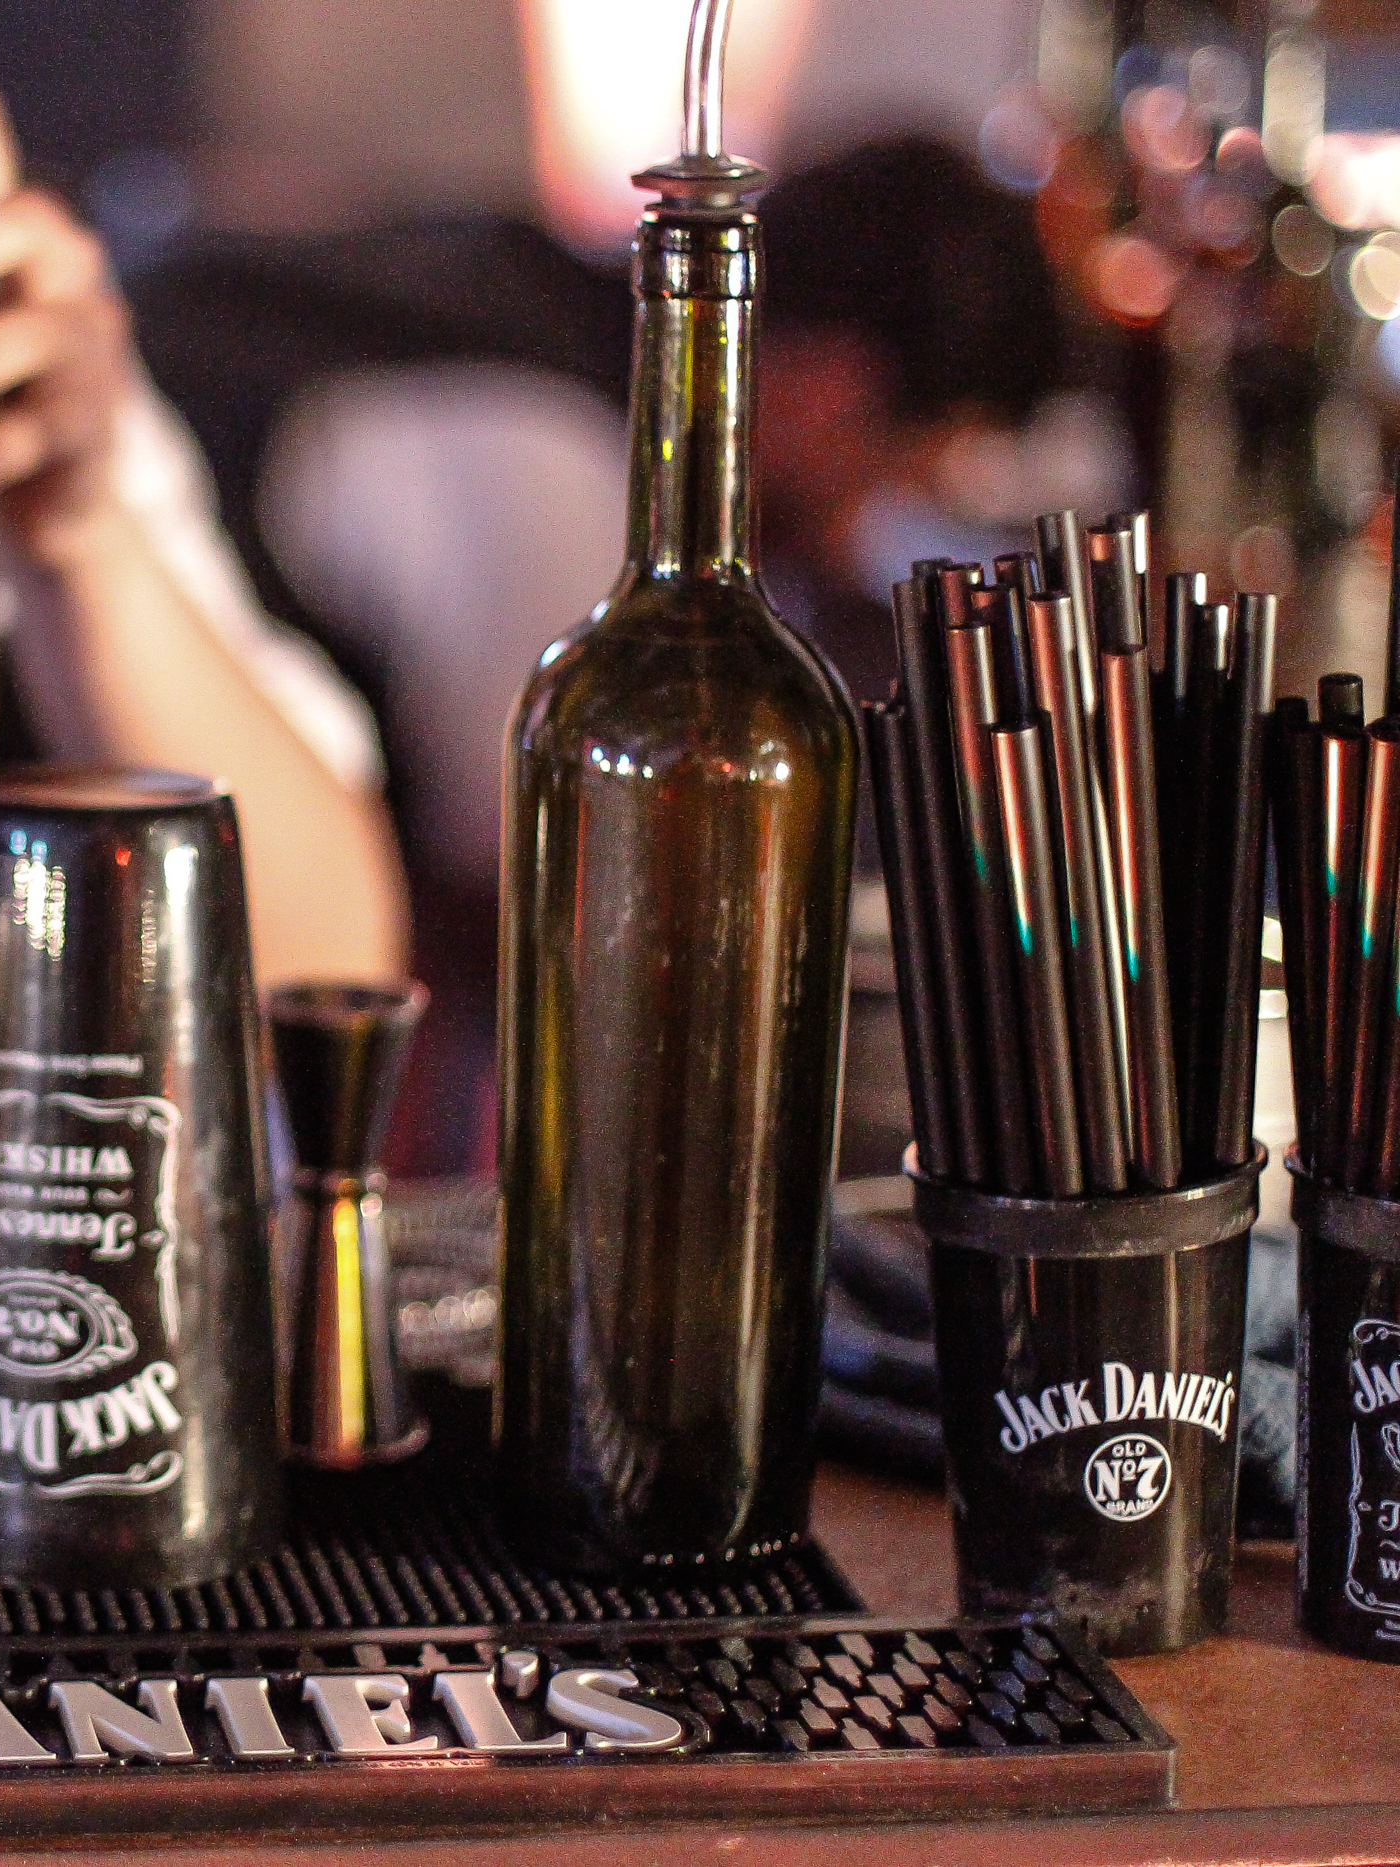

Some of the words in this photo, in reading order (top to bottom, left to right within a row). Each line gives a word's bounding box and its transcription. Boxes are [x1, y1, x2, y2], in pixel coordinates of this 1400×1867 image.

[59, 1361, 183, 1458] JACK
[993, 1378, 1102, 1453] JACK
[1102, 1361, 1236, 1443] DANIEL'S
[1353, 1357, 1400, 1414] JAC
[1111, 1440, 1147, 1458] OLD
